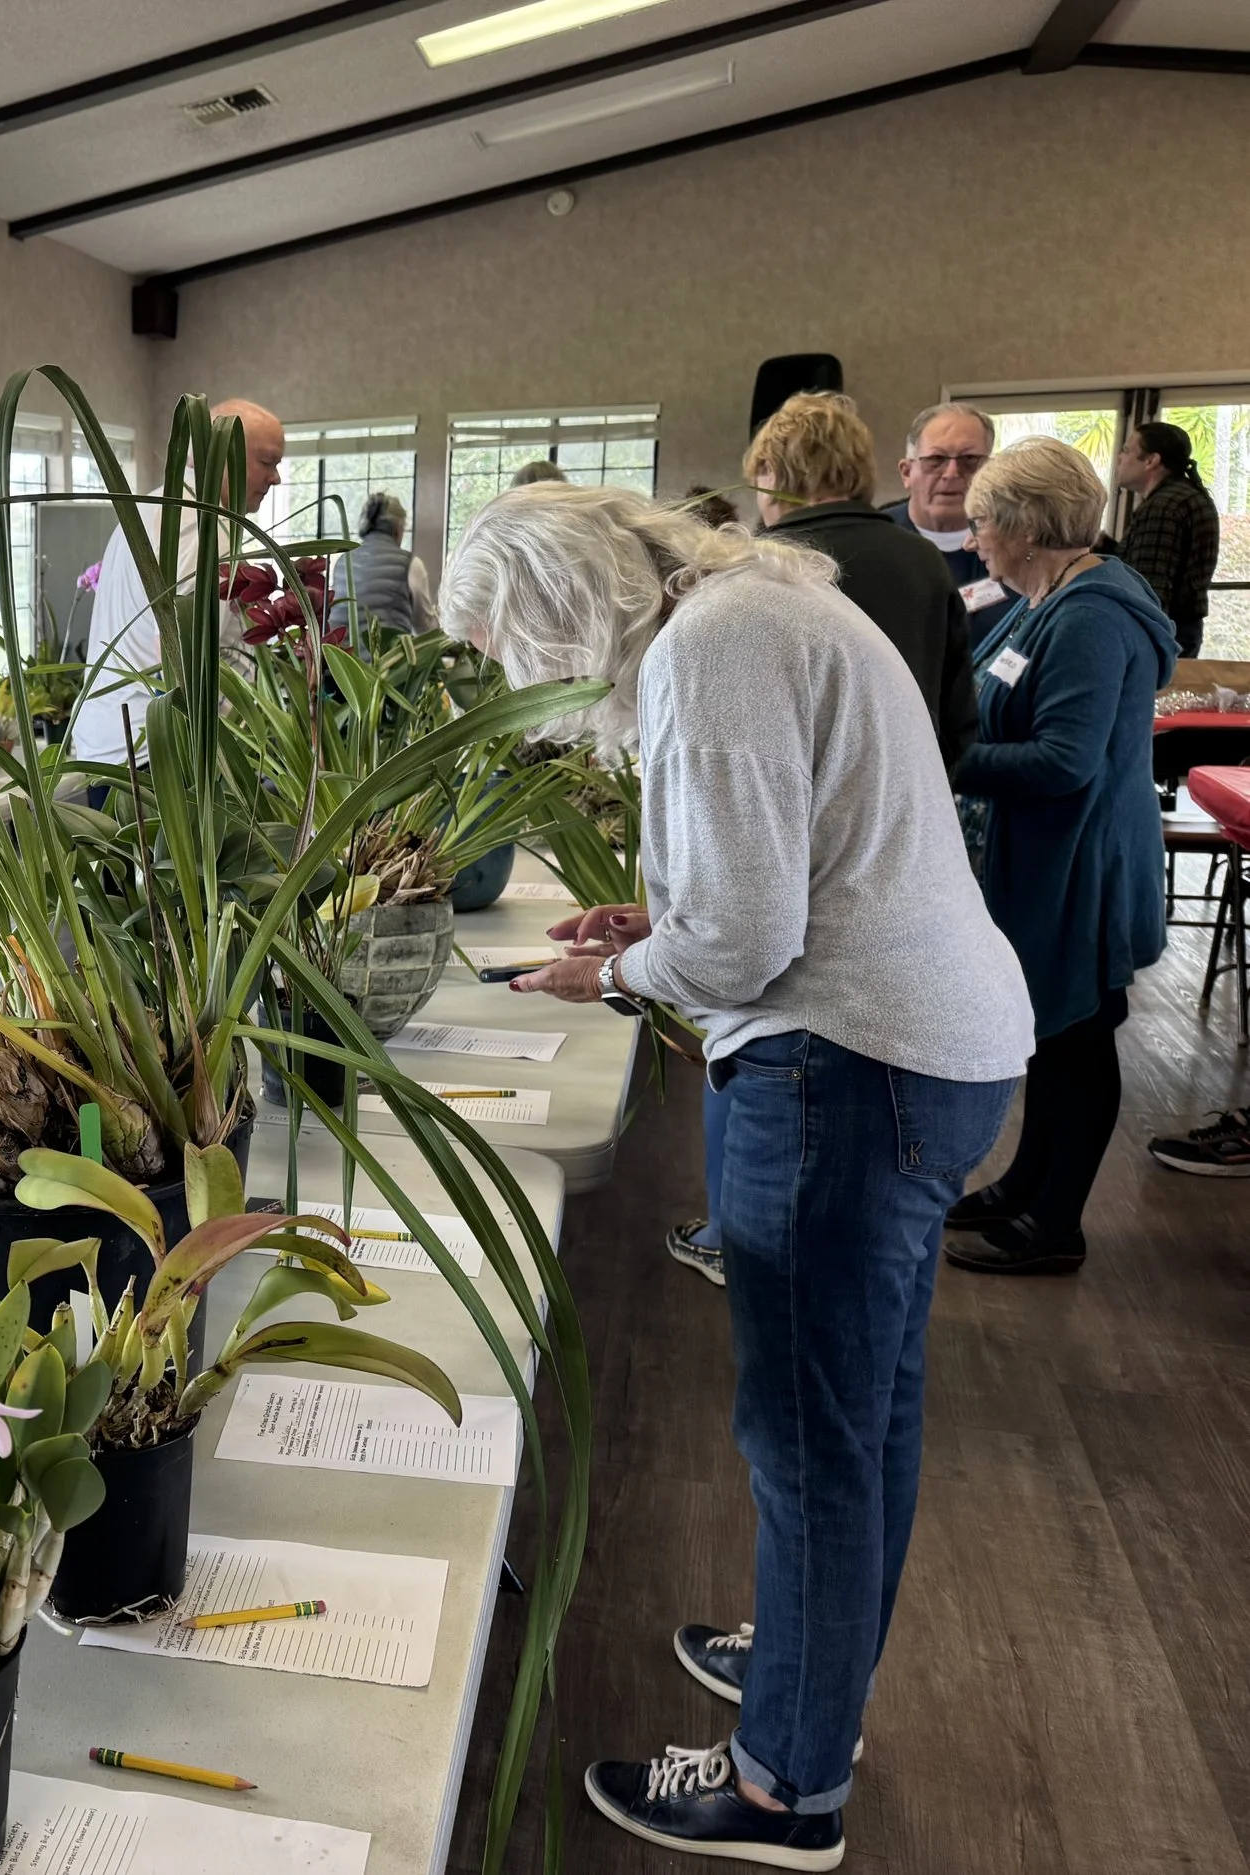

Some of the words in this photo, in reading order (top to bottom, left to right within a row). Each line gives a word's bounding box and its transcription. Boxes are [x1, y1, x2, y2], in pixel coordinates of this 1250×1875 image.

[238, 1649, 247, 1660] Bids
[4, 1822, 22, 1849] Society
[76, 1827, 87, 1844] flower
[84, 1808, 97, 1827] season)
[10, 1851, 21, 1864] Bid
[16, 1832, 29, 1851] Sheet
[30, 1843, 46, 1867] Starting
[40, 1834, 50, 1845] Bid
